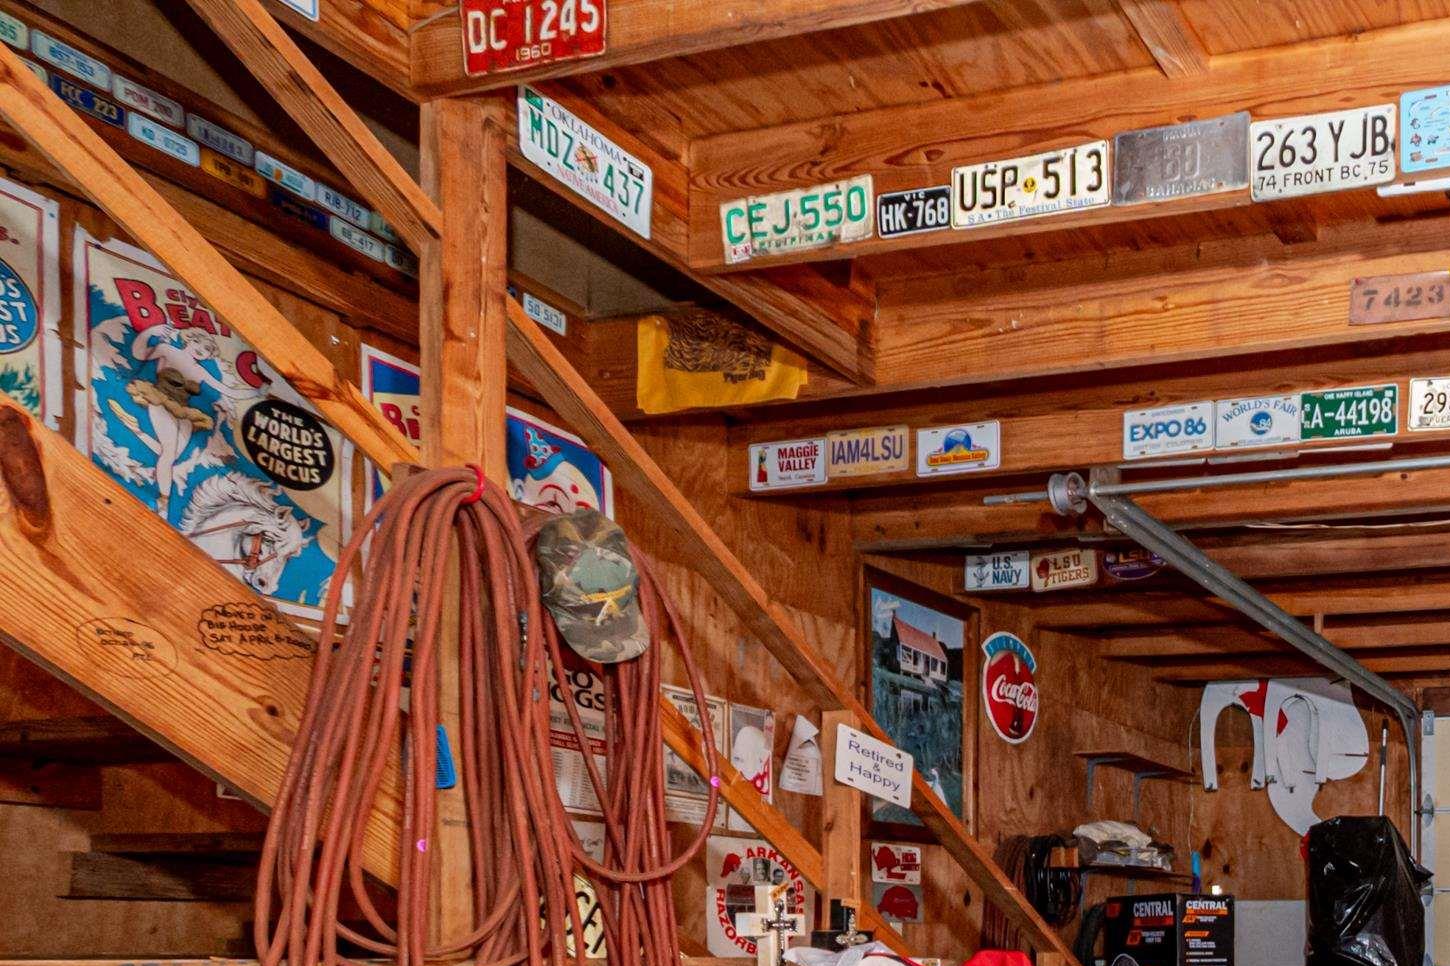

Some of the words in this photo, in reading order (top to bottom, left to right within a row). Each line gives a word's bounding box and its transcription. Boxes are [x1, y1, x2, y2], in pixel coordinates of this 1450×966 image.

[467, 9, 507, 53] DC
[523, 0, 599, 43] 1245
[516, 43, 551, 61] 1960
[551, 101, 623, 167] OKLAHOMA
[1257, 125, 1317, 171] 263
[528, 105, 575, 172] MDZ
[603, 162, 645, 215] 437
[959, 165, 1019, 212] USP
[1043, 149, 1103, 199] 513
[1257, 174, 1277, 192] 74
[1283, 167, 1334, 187] FRONT
[1340, 164, 1360, 180] BC
[1369, 159, 1389, 174] 75
[904, 191, 925, 201] VIC
[1019, 199, 1061, 214] Festival
[1362, 284, 1446, 311] 7423
[271, 407, 304, 428] THE
[1273, 400, 1298, 417] FAIR
[254, 411, 324, 448] WORLD'S
[1130, 419, 1182, 442] EXPO
[1184, 416, 1207, 437] 86
[1333, 427, 1362, 436] ARUBA
[247, 427, 328, 467] LARGEST
[777, 444, 819, 460] MAGGIE
[256, 450, 321, 484] CIRCUS
[778, 457, 817, 473] VALLEY
[1052, 554, 1081, 570] LSU
[992, 568, 1023, 585] NAVY
[1050, 566, 1090, 585] TIGERS
[848, 739, 904, 772] Retired
[849, 761, 902, 792] Happy
[1133, 901, 1174, 918] CENTRAL
[1185, 900, 1228, 910] CENTRAL
